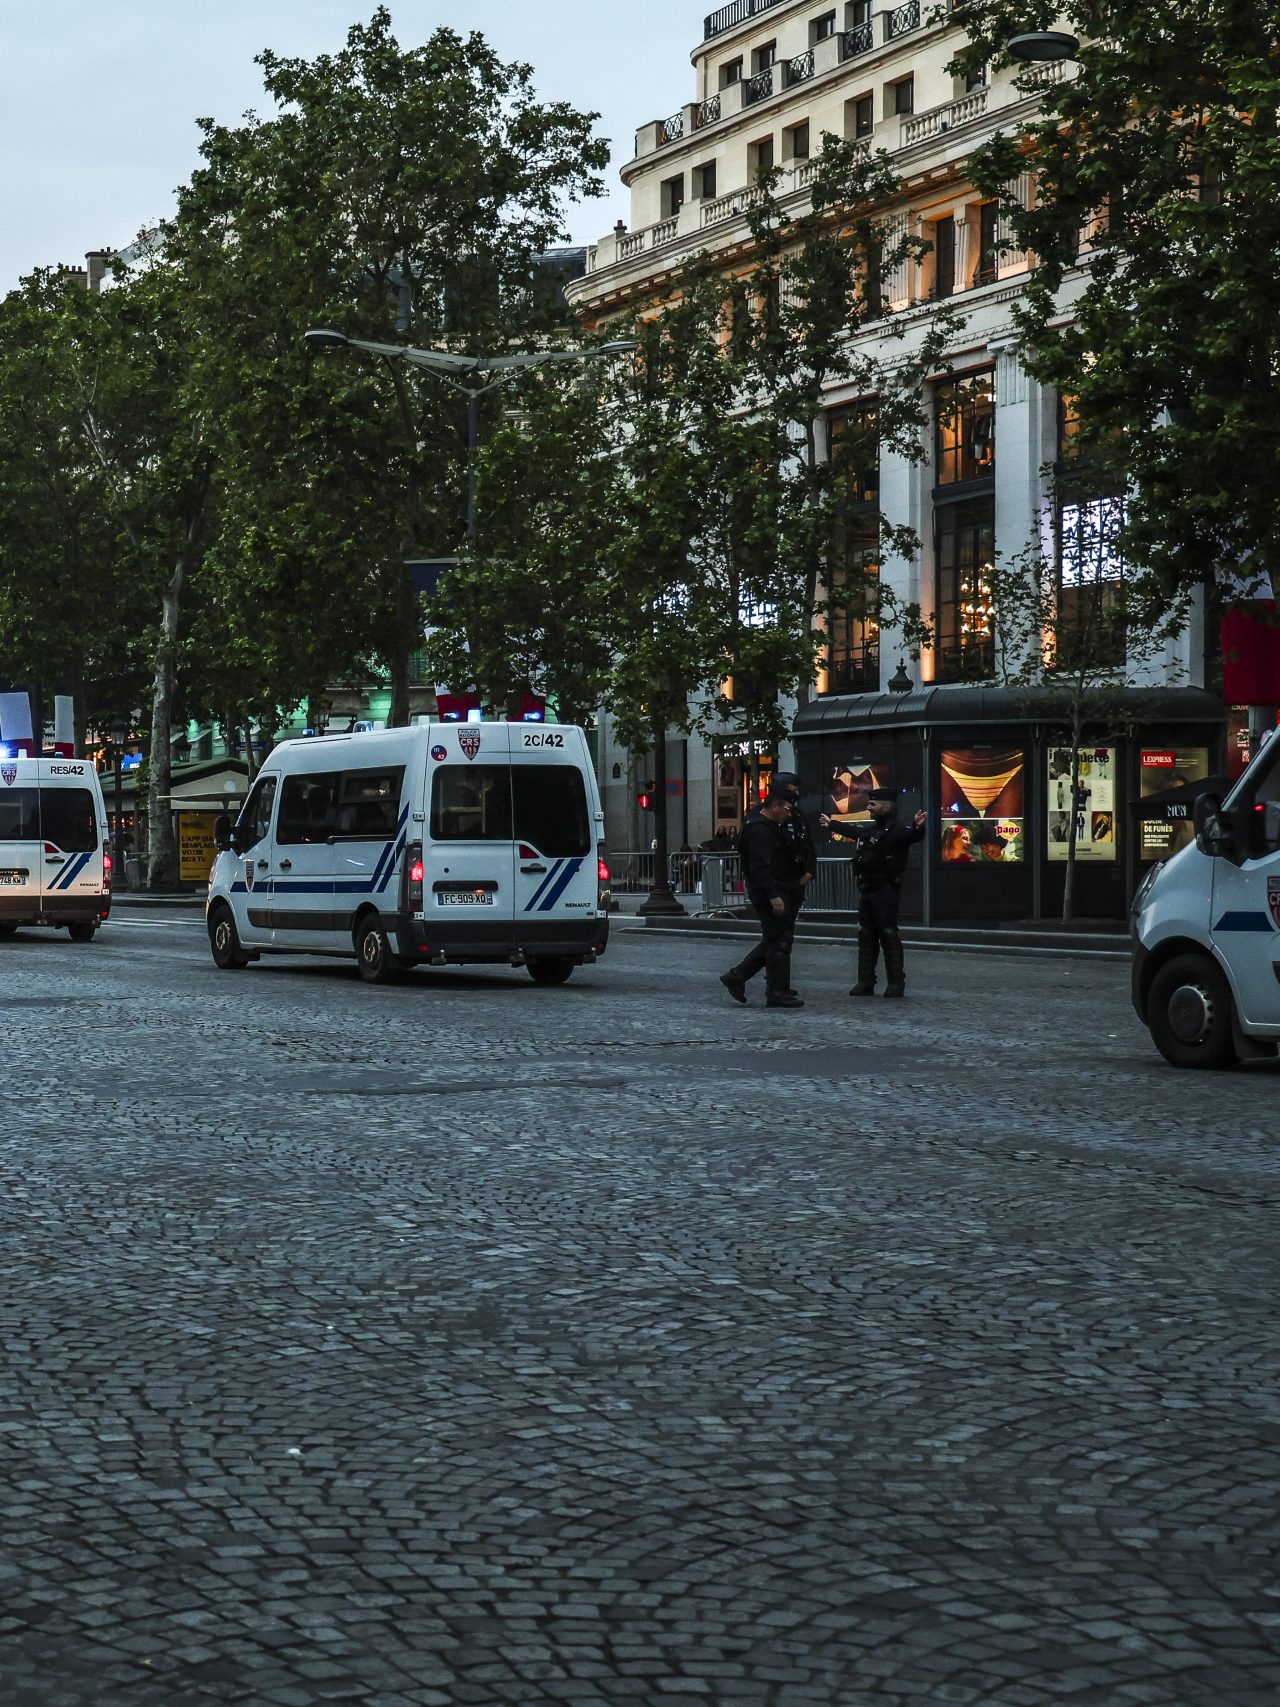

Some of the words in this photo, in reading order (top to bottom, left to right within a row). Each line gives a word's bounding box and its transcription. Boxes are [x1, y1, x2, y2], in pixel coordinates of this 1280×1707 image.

[460, 738, 479, 746] CRS
[524, 733, 564, 748] 2C/42
[50, 765, 85, 776] RES/42
[996, 825, 1021, 836] pago
[1144, 825, 1152, 833] DE
